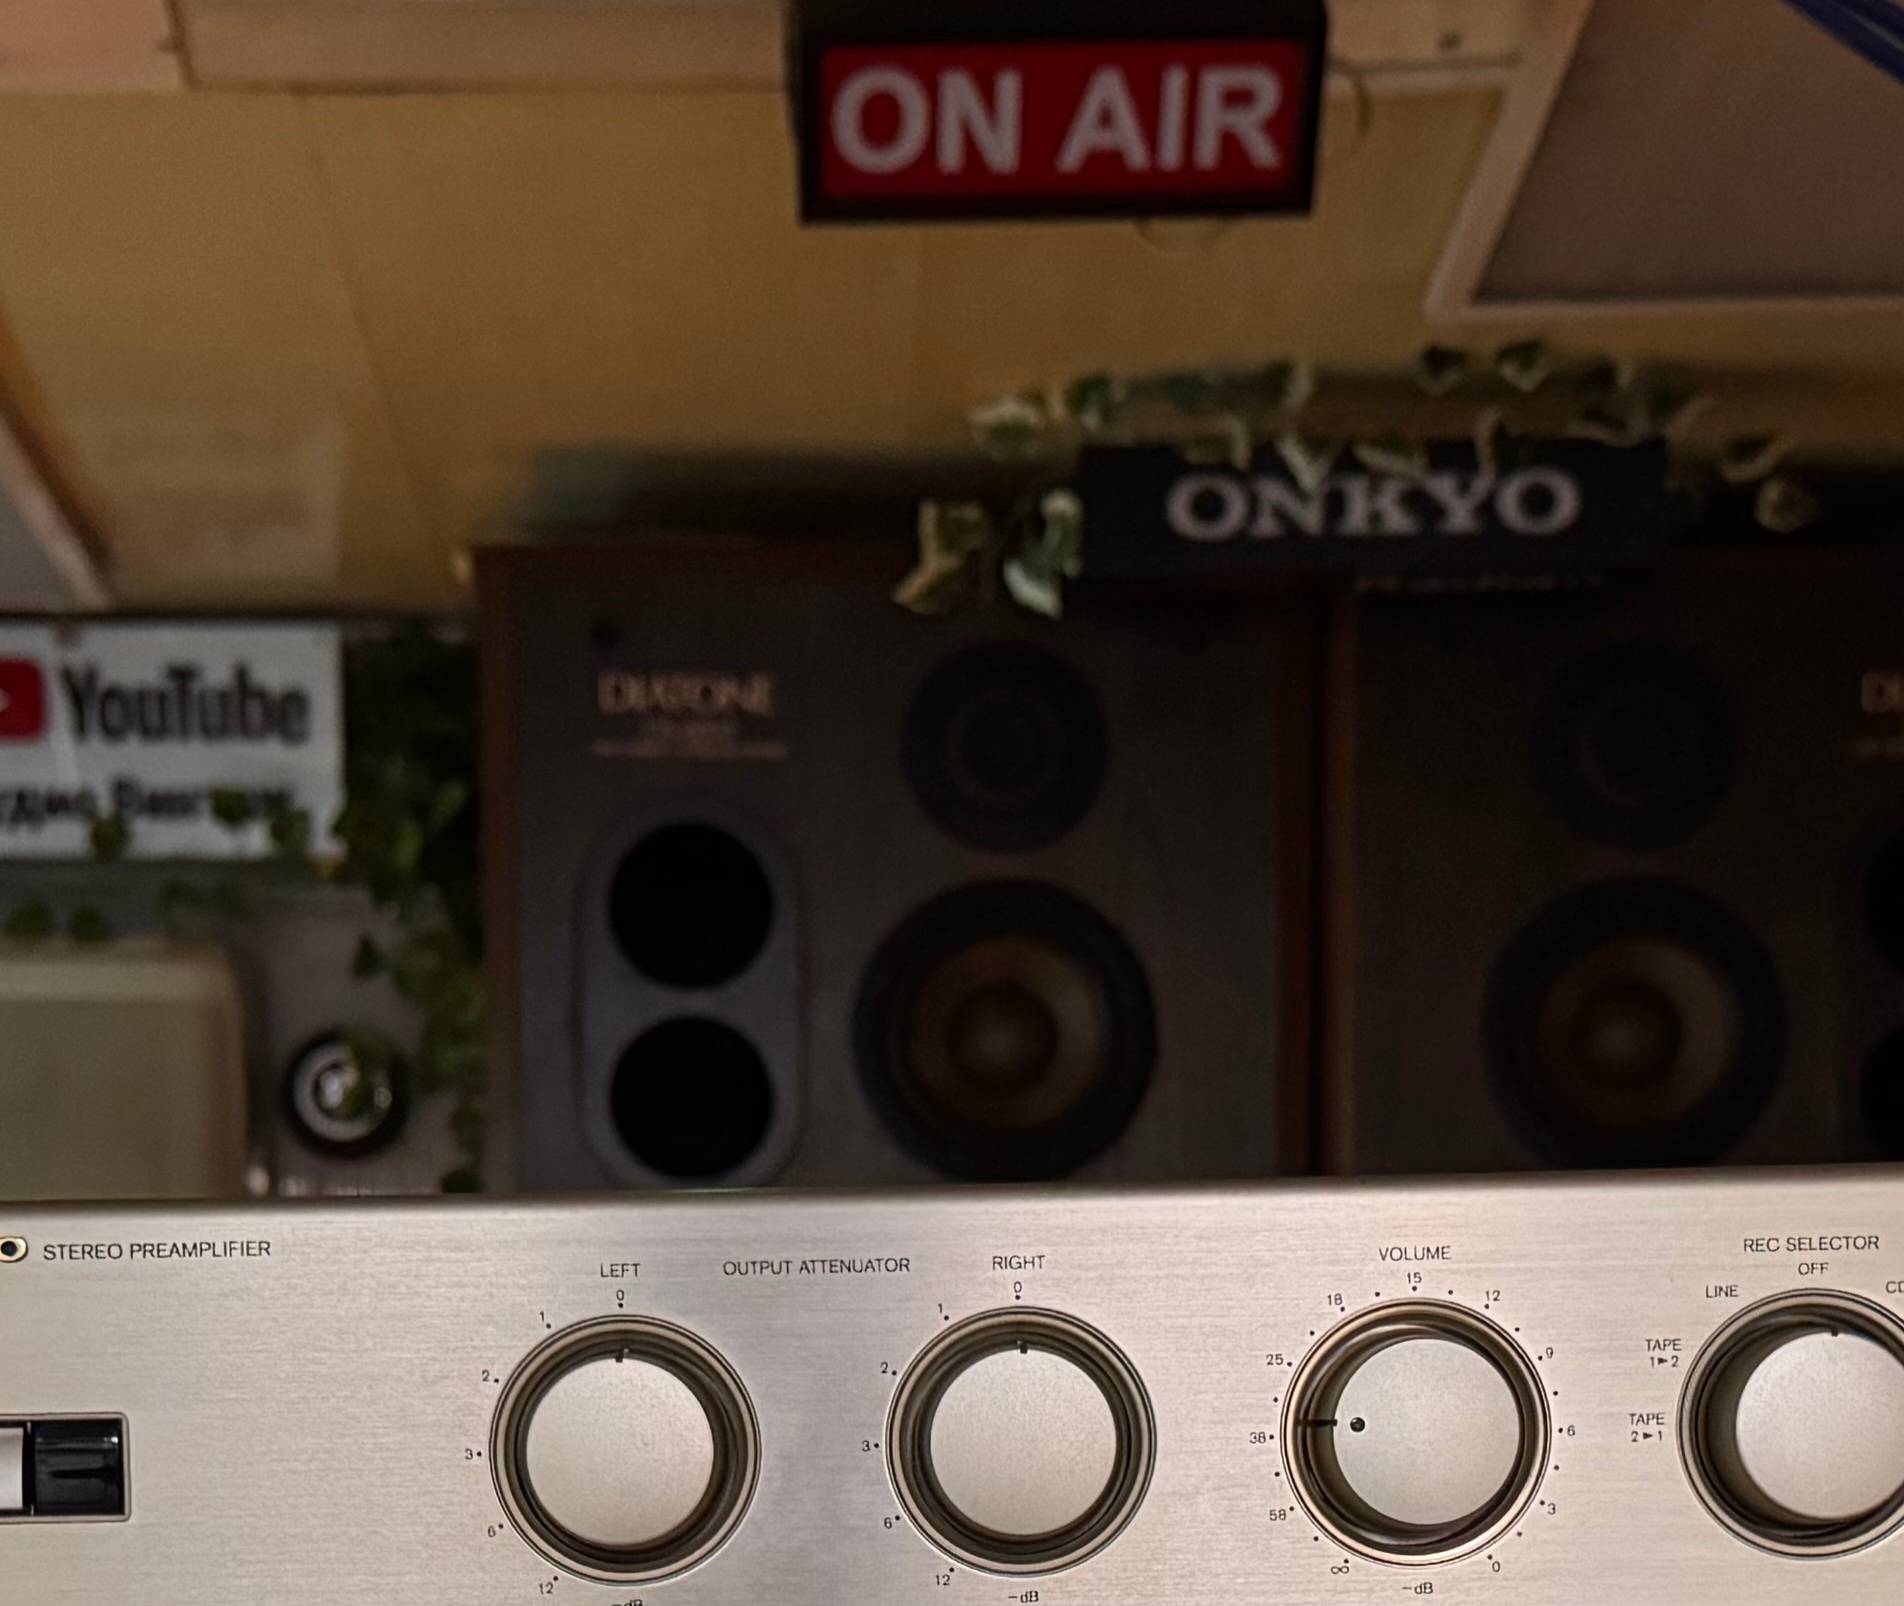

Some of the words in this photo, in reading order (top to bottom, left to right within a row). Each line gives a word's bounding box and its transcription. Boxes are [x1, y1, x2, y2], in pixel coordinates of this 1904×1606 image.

[830, 64, 1023, 175] ON
[1057, 65, 1283, 173] AIR
[1166, 467, 1580, 541] ONKYO
[61, 660, 310, 744] YouTube
[1743, 1238, 1780, 1252] REC
[1786, 1235, 1879, 1251] SELECTOR
[42, 1241, 123, 1260] STEREO
[129, 1240, 271, 1259] PREAMPLIFIER
[1379, 1246, 1451, 1261] VOLUME
[723, 1260, 793, 1276] OUTPUT
[799, 1257, 910, 1274] ATTENUATOR
[992, 1255, 1045, 1270] RIGHT
[600, 1263, 641, 1278] LEFT
[1798, 1263, 1828, 1275] OFF
[1407, 1273, 1422, 1284] 15
[1013, 1282, 1022, 1294] 0
[1705, 1285, 1738, 1299] LINE
[616, 1289, 625, 1301] 0
[1327, 1294, 1342, 1306] 18
[1485, 1290, 1500, 1302] 12
[937, 1303, 943, 1314] 1
[539, 1311, 545, 1323] 1
[1645, 1339, 1682, 1351] TAPE
[1266, 1354, 1283, 1366] 25
[881, 1362, 888, 1374] 2
[481, 1370, 490, 1382] 2
[1629, 1413, 1666, 1425] TAPE
[1567, 1425, 1575, 1437] 6
[1249, 1432, 1266, 1444] 38
[862, 1440, 870, 1452] 3
[464, 1448, 473, 1460] 3
[1269, 1509, 1286, 1521] 58
[1547, 1503, 1556, 1515] 3
[884, 1517, 892, 1529] 6
[487, 1526, 496, 1538] 6
[1492, 1561, 1501, 1573] 0
[935, 1574, 951, 1587] 12
[538, 1582, 554, 1595] 12
